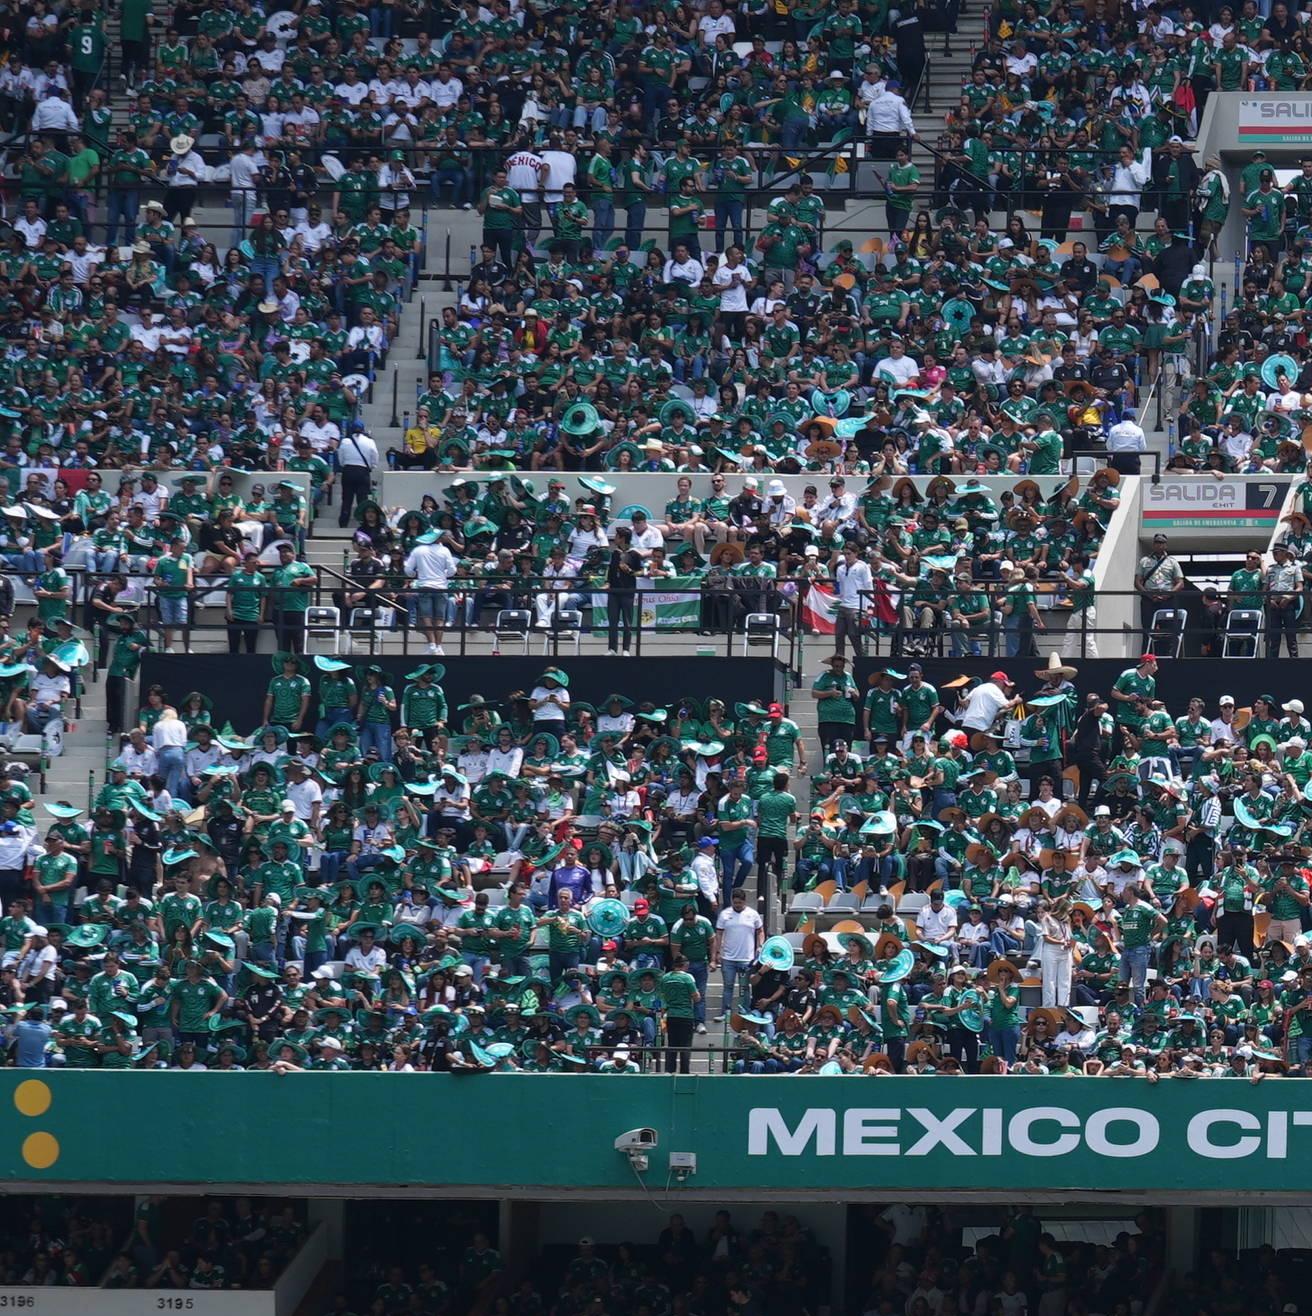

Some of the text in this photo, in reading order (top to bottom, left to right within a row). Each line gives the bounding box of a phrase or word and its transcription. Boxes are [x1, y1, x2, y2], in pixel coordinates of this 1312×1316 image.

[81, 35, 93, 54] 9
[504, 154, 542, 172] MEXICO
[1150, 484, 1278, 508] SALIDA 7
[748, 1106, 1160, 1158] MEXICO
[0, 1295, 35, 1308] 3196
[158, 1297, 194, 1310] 3195
